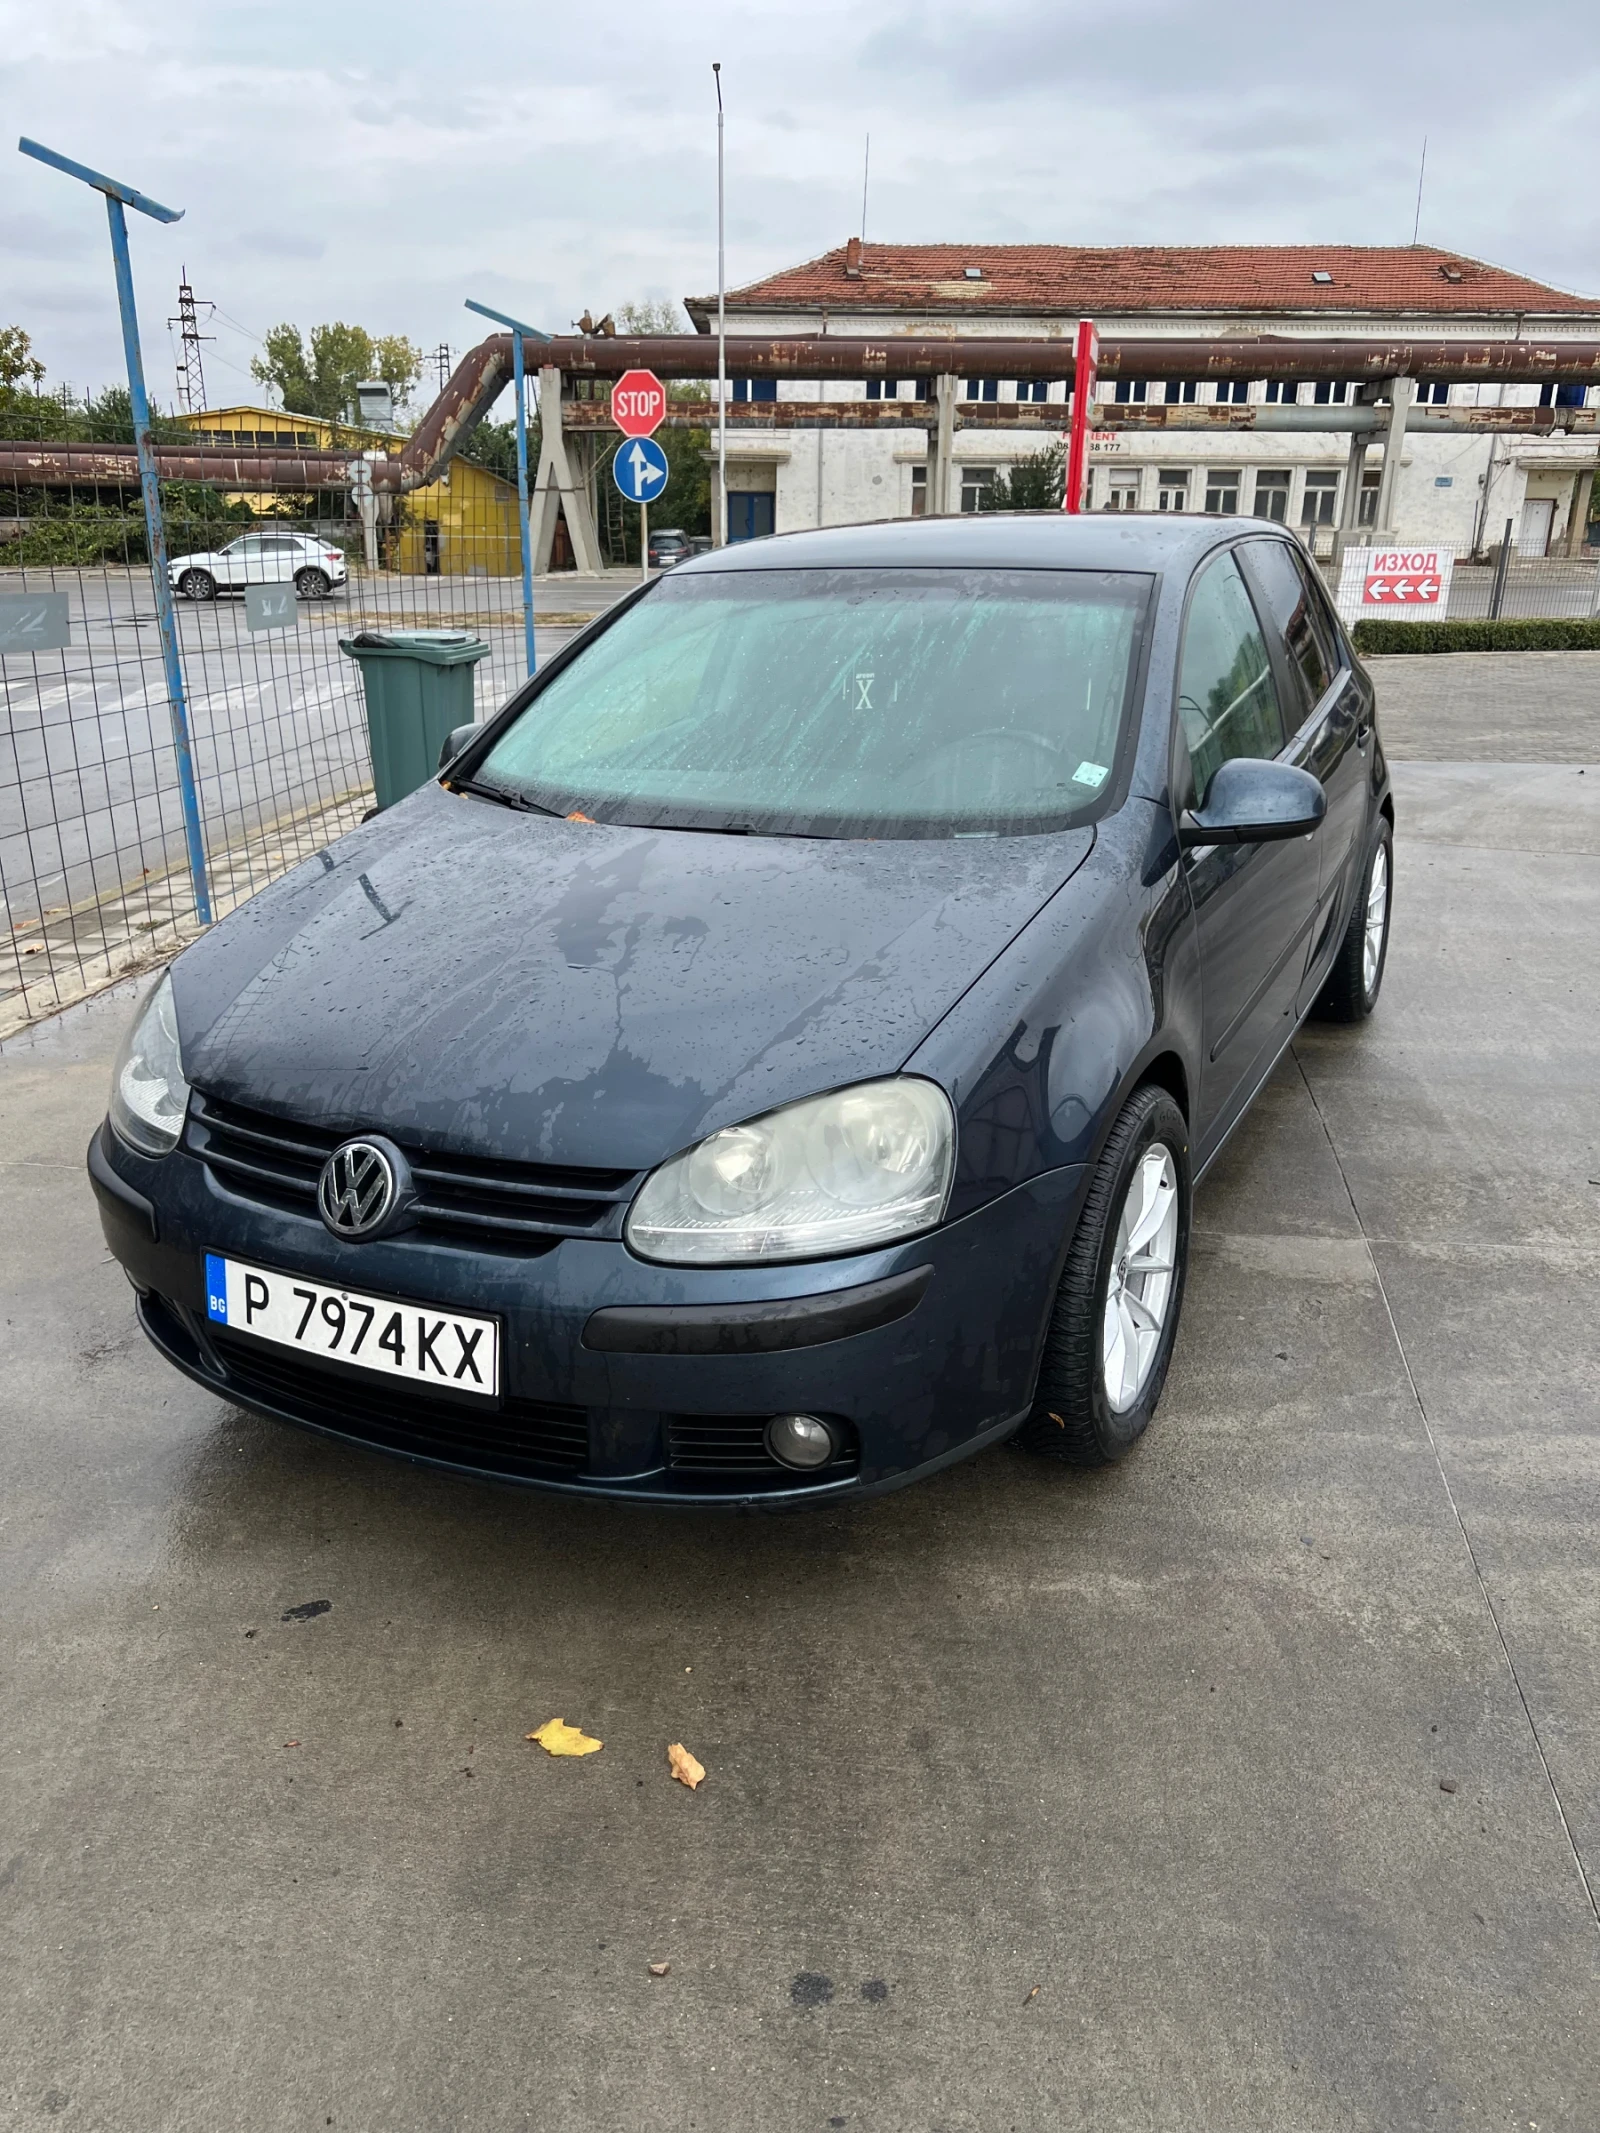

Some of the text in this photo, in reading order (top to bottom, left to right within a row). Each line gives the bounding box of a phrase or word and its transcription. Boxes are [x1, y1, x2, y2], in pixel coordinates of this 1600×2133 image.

[617, 391, 661, 417] STOP
[1104, 444, 1121, 453] 177
[1374, 553, 1438, 574] ИЗХОД
[209, 1295, 226, 1314] BG
[245, 1273, 269, 1325] P
